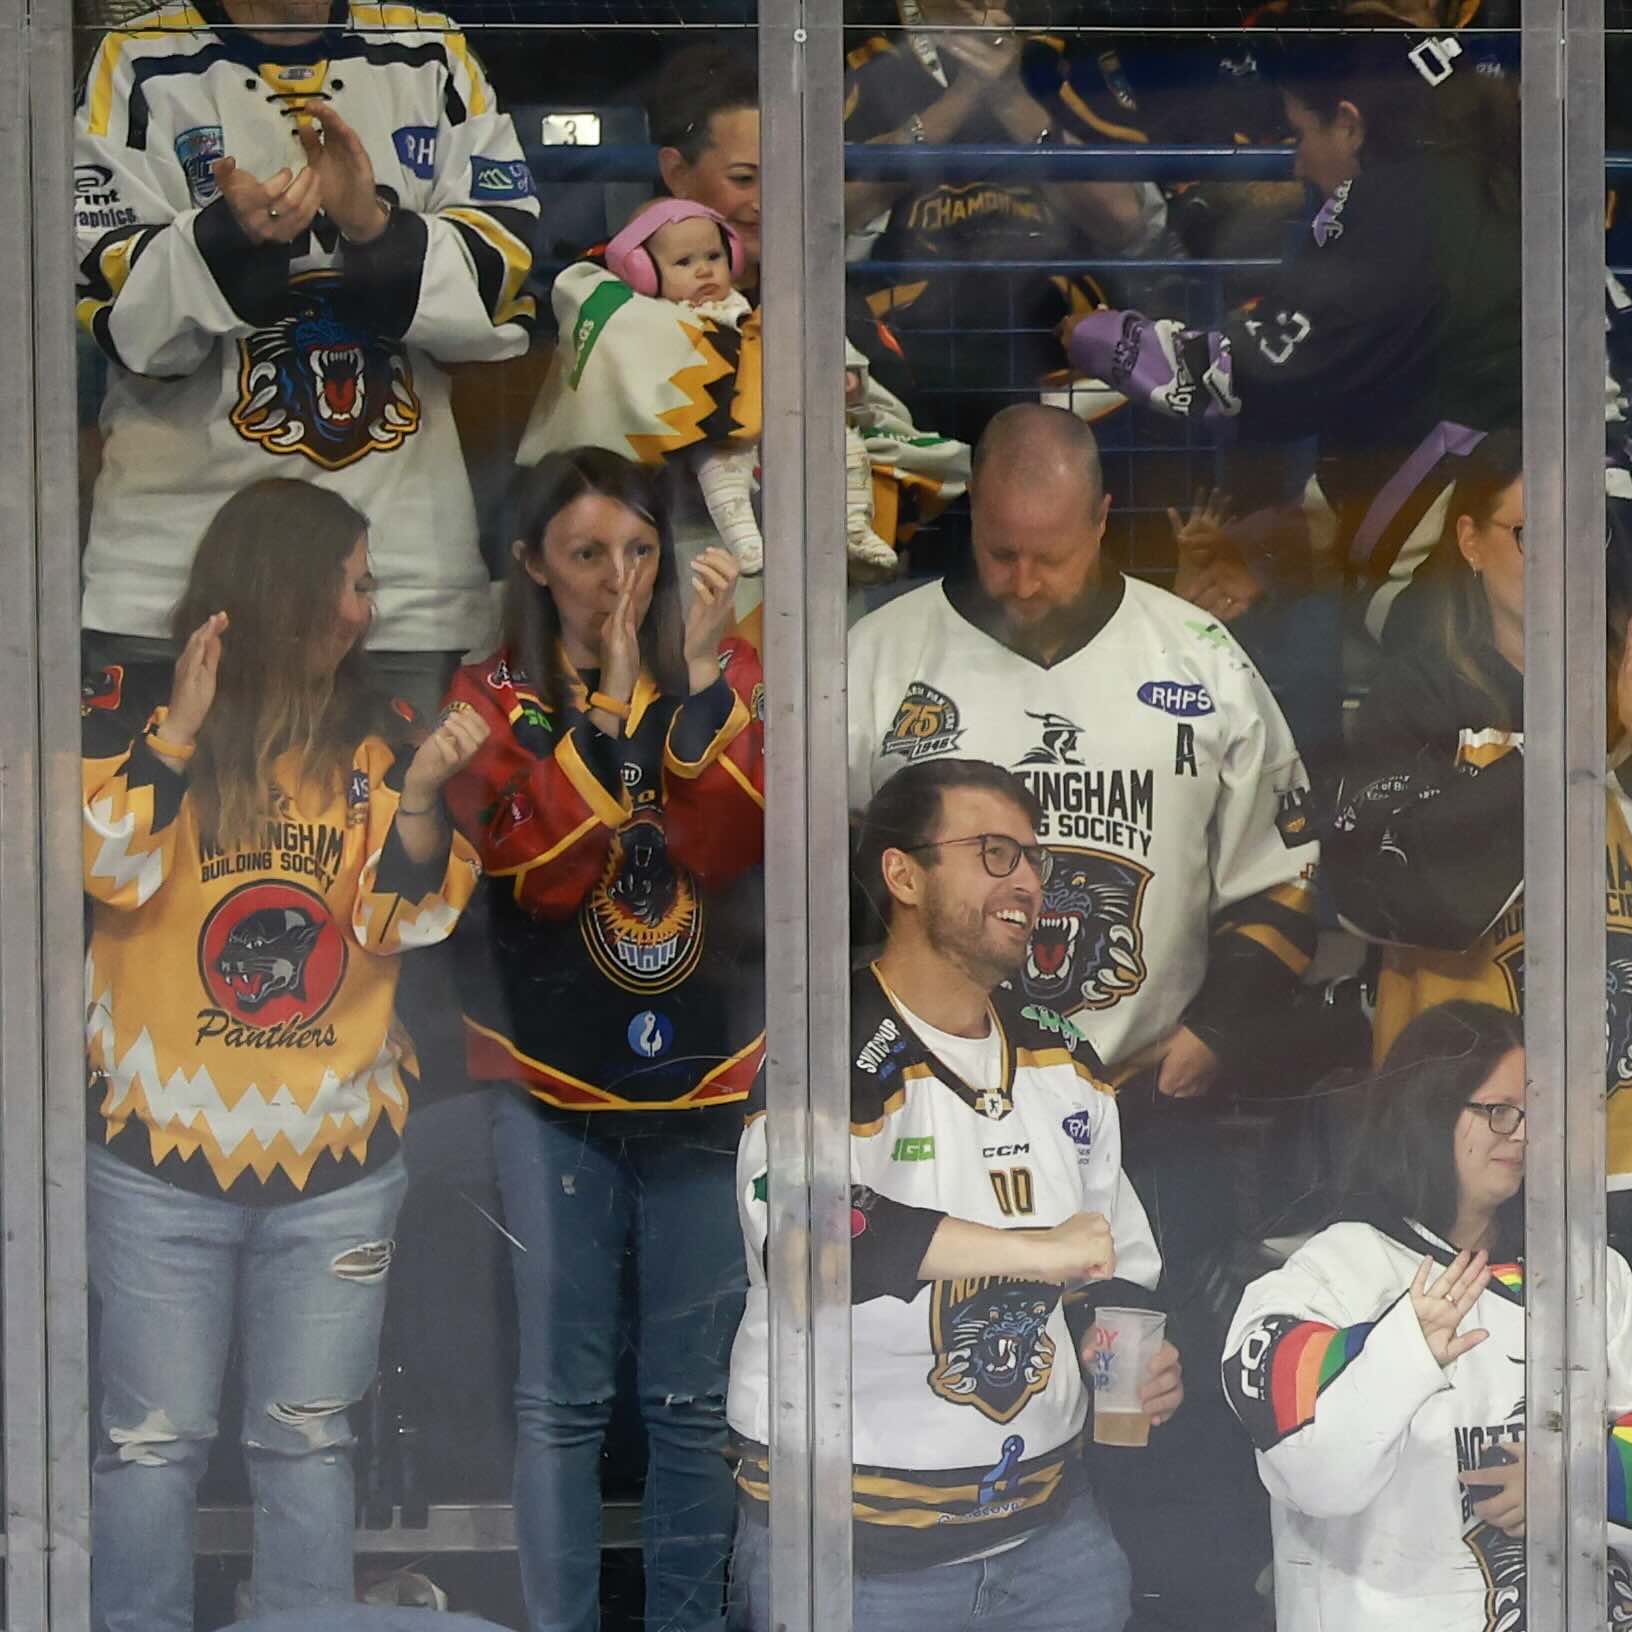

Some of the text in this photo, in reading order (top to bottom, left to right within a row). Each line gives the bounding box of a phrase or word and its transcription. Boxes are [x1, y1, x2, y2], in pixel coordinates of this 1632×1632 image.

[405, 134, 435, 165] RH
[1151, 686, 1212, 712] RHPS
[895, 703, 945, 737] 75
[1174, 721, 1199, 778] A
[1014, 769, 1154, 837] TINGHAM
[1058, 813, 1153, 857] SOCIETY
[201, 852, 272, 883] BUILDING
[195, 1008, 337, 1051] Panthers
[982, 1142, 1031, 1159] CCM
[1454, 1422, 1527, 1473] NOTT
